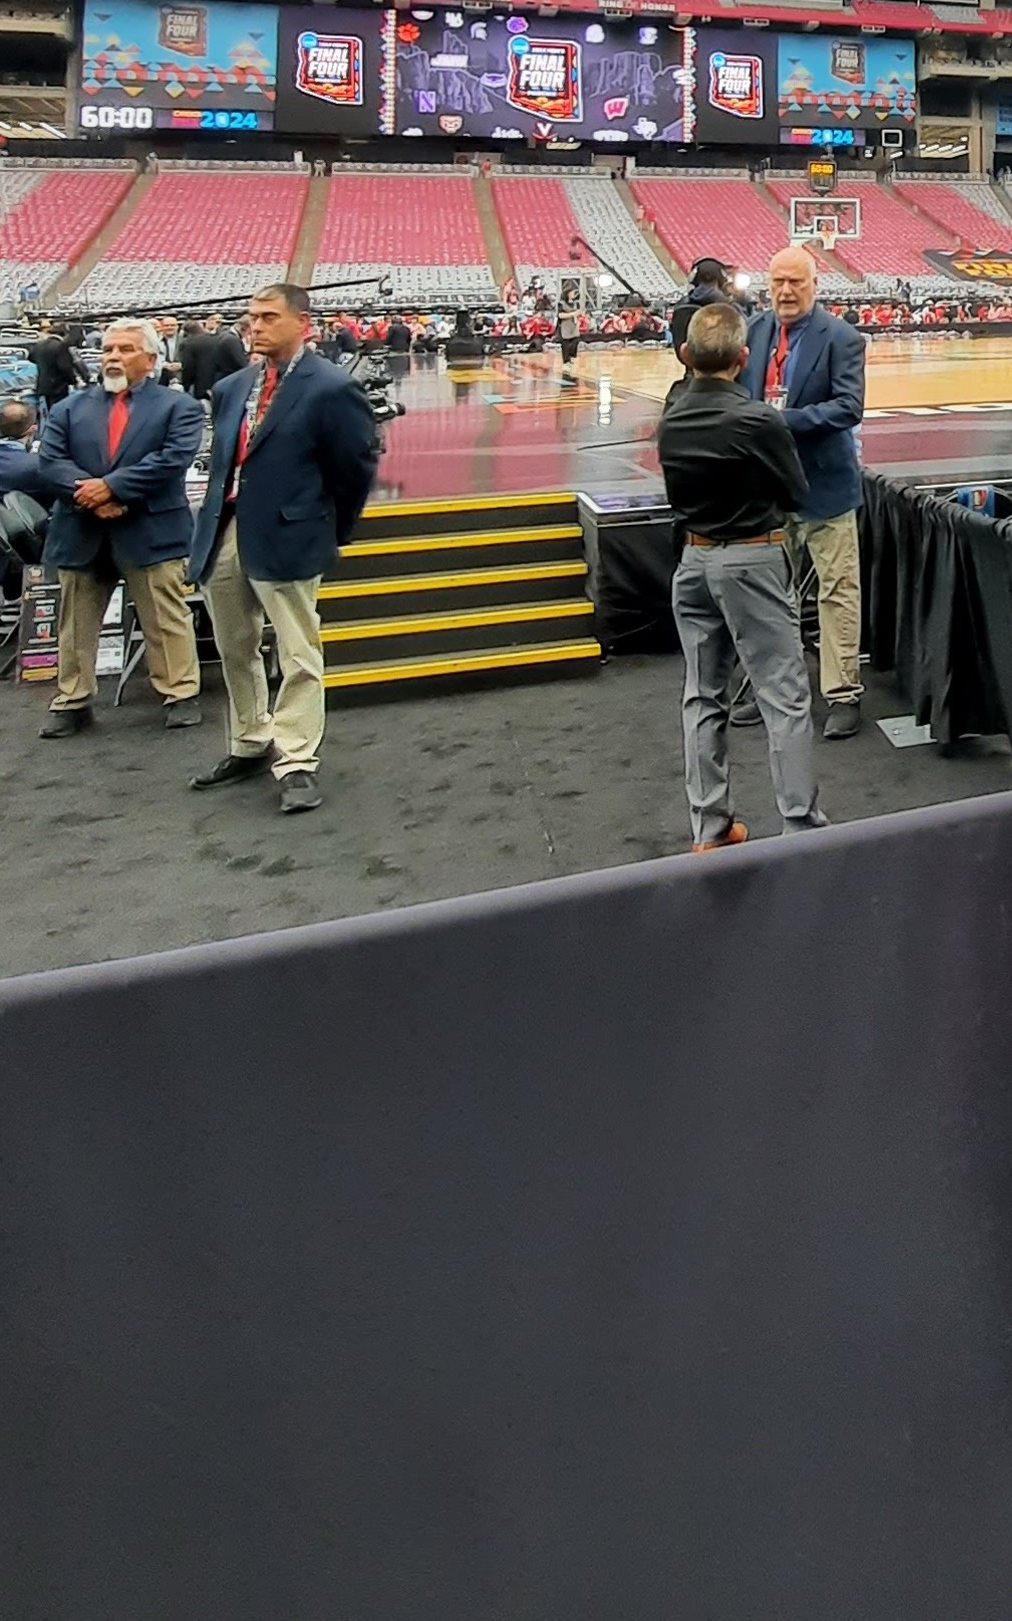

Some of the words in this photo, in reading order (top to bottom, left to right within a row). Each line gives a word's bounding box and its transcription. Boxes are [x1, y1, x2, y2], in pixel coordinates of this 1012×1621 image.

[598, 0, 624, 8] RING
[640, 1, 676, 11] HONOR
[166, 24, 198, 37] FOUR
[308, 47, 349, 63] FINAL
[519, 54, 566, 71] FINAL
[307, 61, 349, 78] FOUR
[718, 66, 751, 79] FINAL
[519, 70, 566, 90] FOUR
[718, 78, 751, 95] FOUR
[81, 106, 153, 128] 60:00
